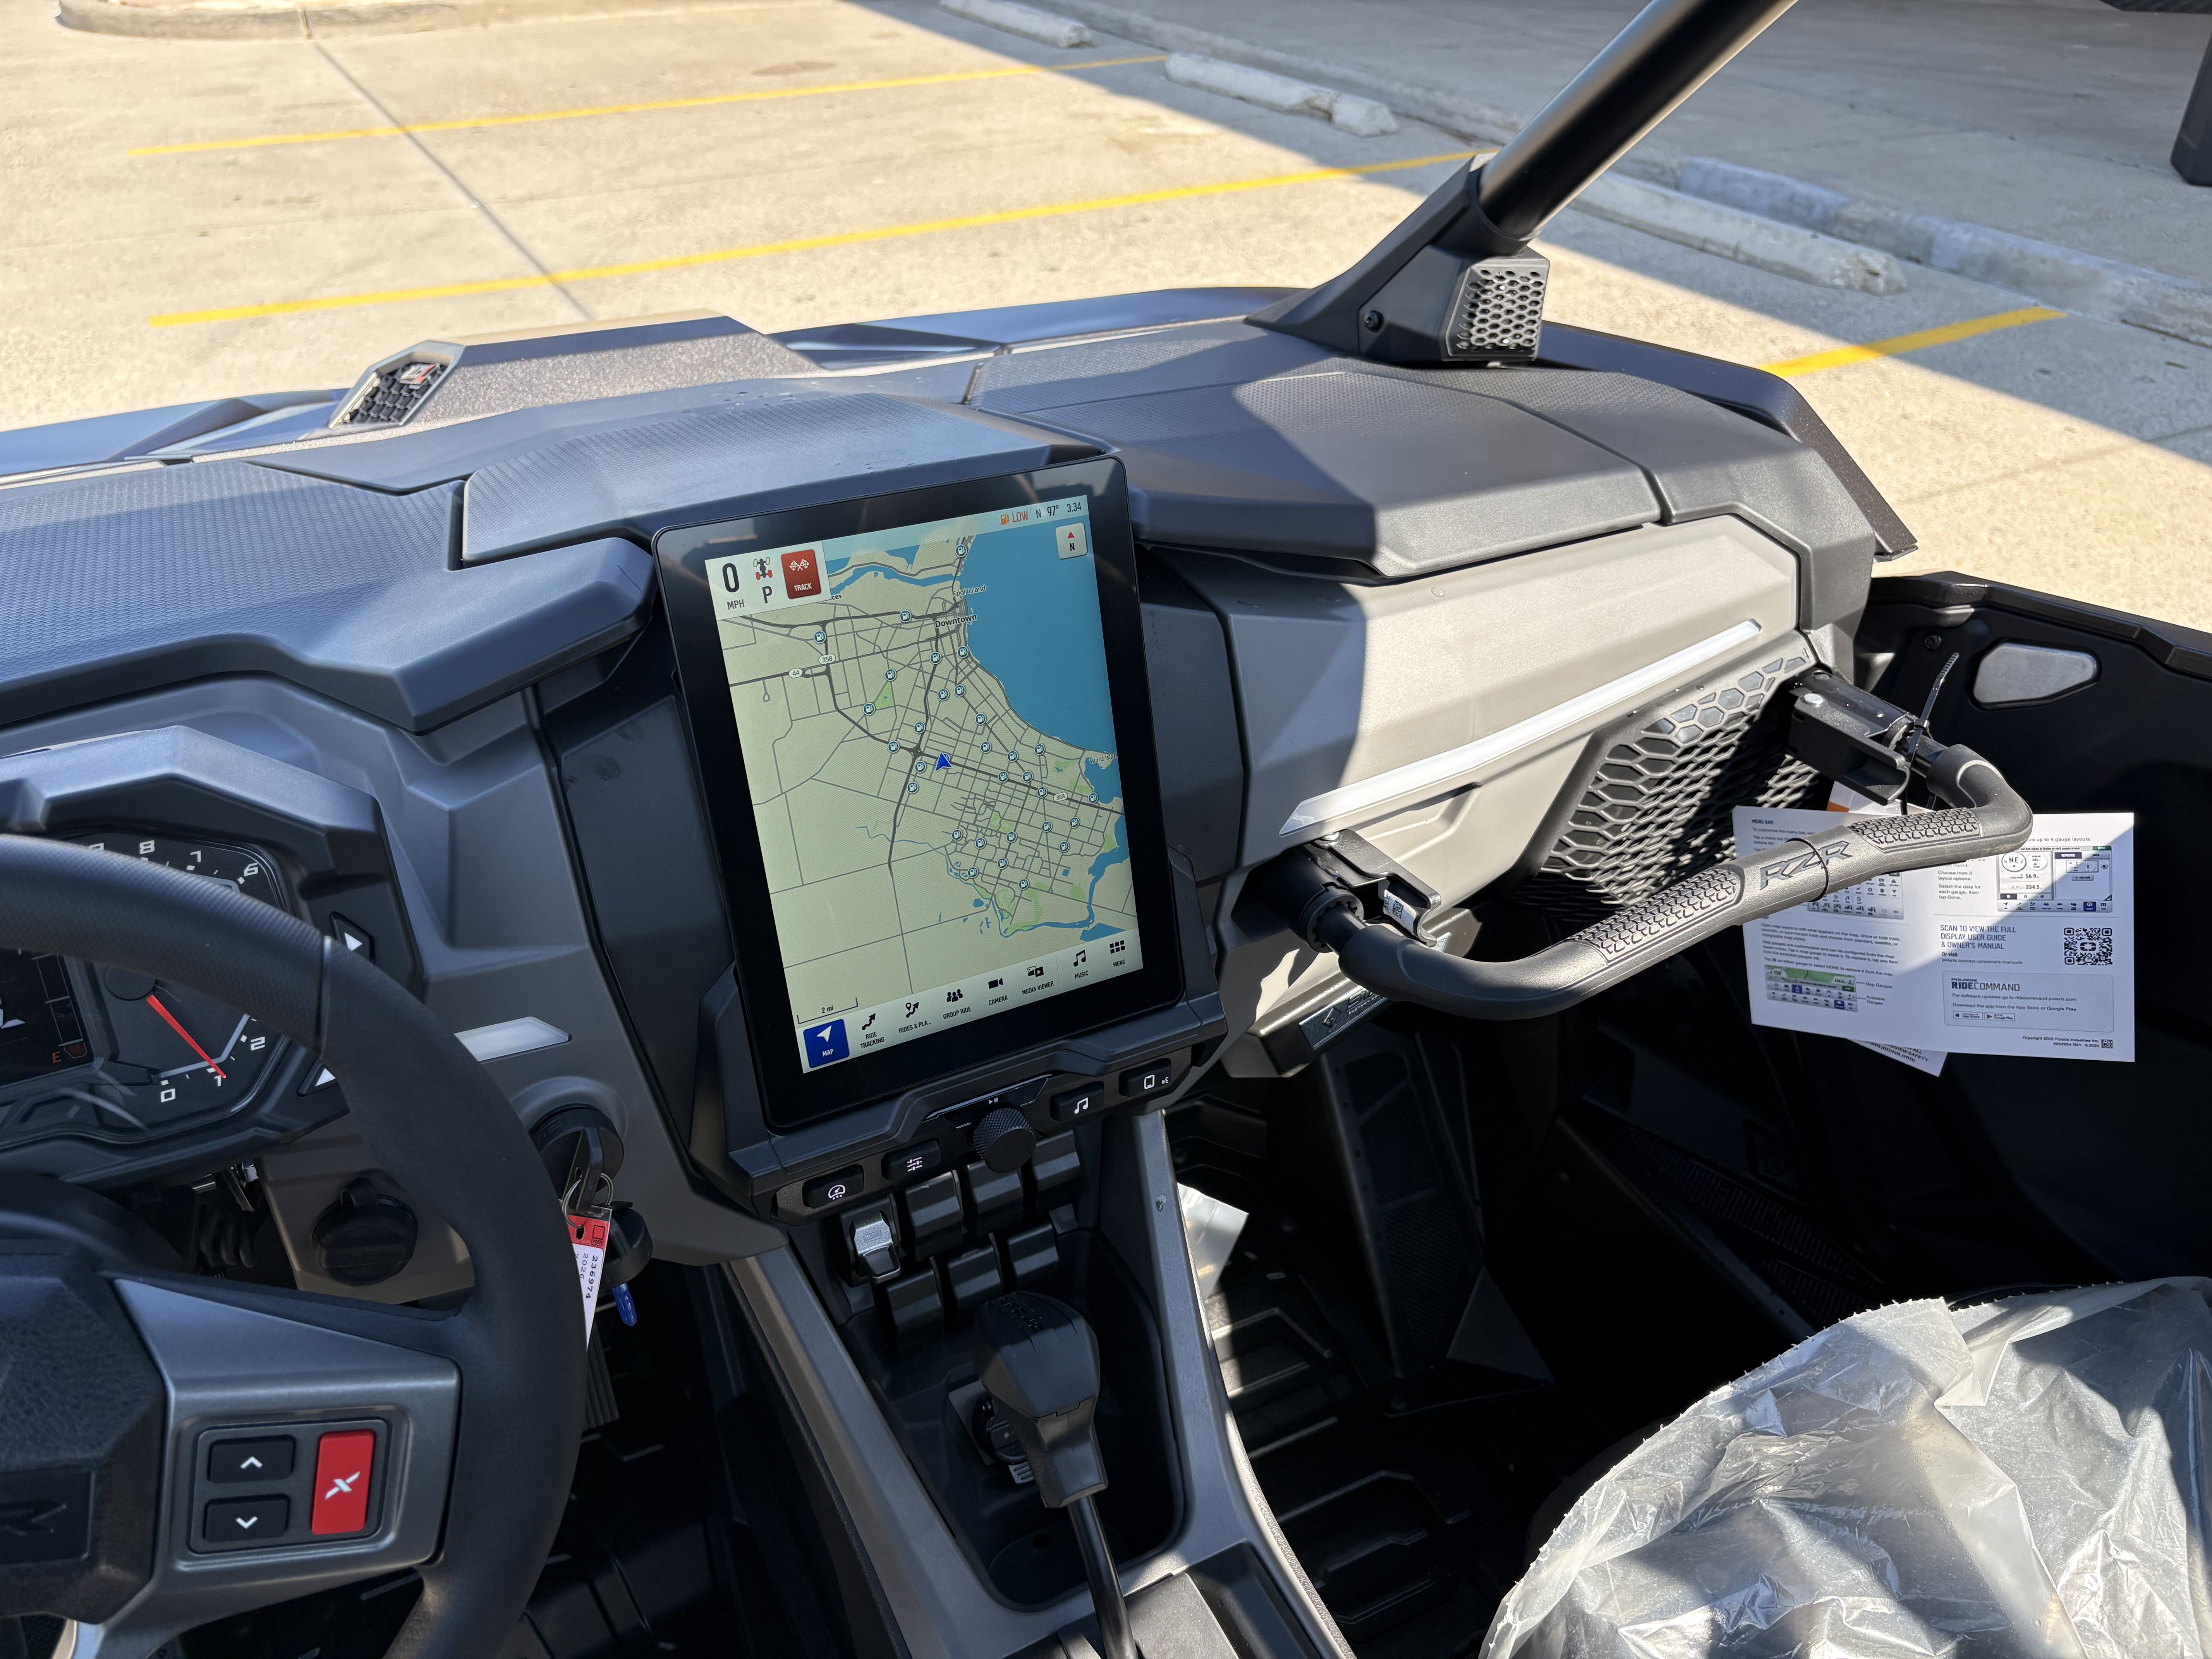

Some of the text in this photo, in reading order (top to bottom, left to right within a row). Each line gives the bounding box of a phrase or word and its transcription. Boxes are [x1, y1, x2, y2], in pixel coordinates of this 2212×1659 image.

[1012, 502, 1081, 523] LOW N 97° 3:34
[1070, 543, 1075, 551] N
[722, 563, 739, 592] 0
[794, 583, 812, 591] TRACK
[762, 586, 772, 603] P
[727, 599, 744, 610] MPH
[935, 615, 977, 628] Downtown
[140, 840, 155, 854] 8
[190, 851, 201, 862] 7
[244, 863, 258, 876] 6
[1760, 840, 1853, 891] RZR
[1113, 959, 1125, 967] MENU
[1022, 981, 1054, 995] MEDIA VIEWER
[1952, 982, 2020, 991] RIDECOMMAND
[989, 995, 1008, 1005] CAMERA
[943, 1010, 959, 1019] GROUP
[899, 1025, 913, 1033] RIDES
[866, 1031, 877, 1039] RIDE
[251, 1036, 265, 1051] 2
[860, 1037, 884, 1049] TRACKING
[52, 1052, 61, 1063] E
[1908, 1052, 1929, 1061] SAFETY
[214, 1075, 222, 1086] 1
[160, 1089, 175, 1102] 0
[580, 1253, 588, 1279] 2026
[586, 1255, 598, 1298] 236974
